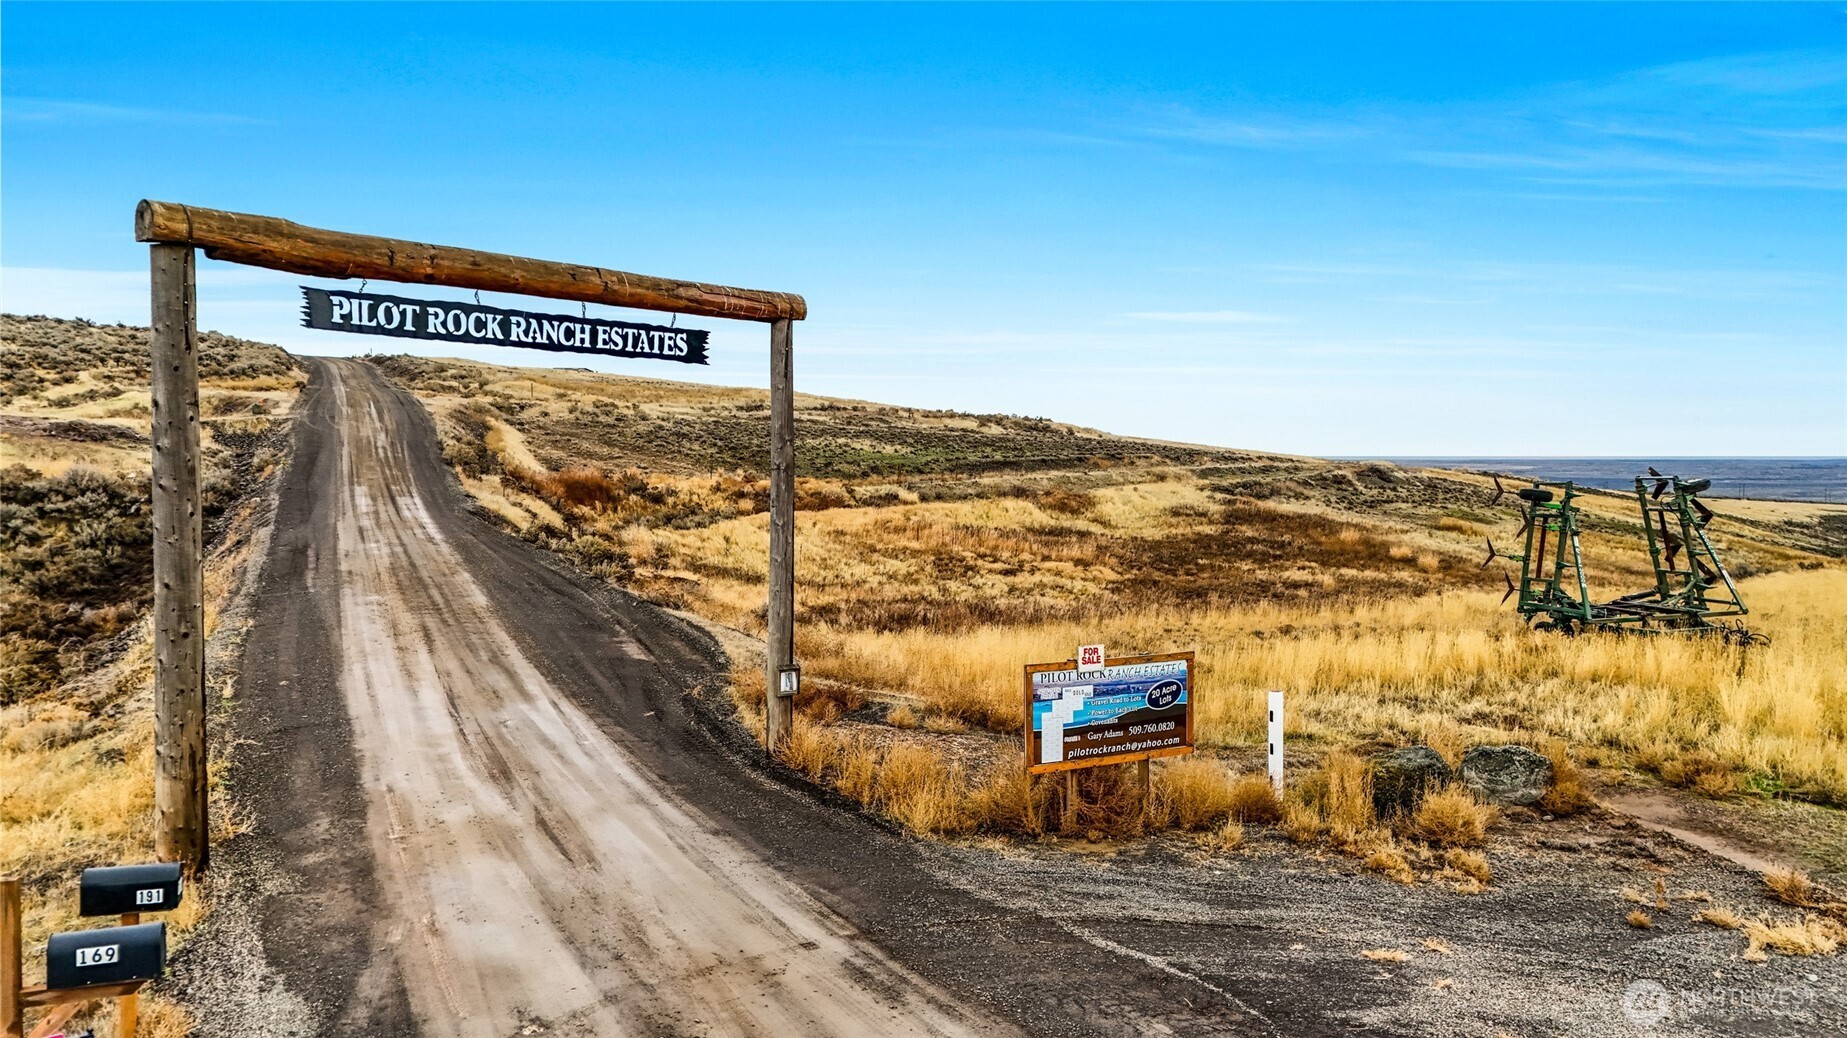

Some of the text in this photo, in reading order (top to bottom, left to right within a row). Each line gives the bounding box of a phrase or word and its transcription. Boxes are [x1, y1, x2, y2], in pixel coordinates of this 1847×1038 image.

[329, 295, 688, 356] PILOT ROCK RANCH ESTATES
[1083, 647, 1099, 656] FOR
[1081, 655, 1101, 665] SALE
[1040, 662, 1182, 684] PILOT ROCK RANCH ESTATES
[1151, 684, 1177, 699] 20 Acre
[1109, 696, 1123, 704] Road
[1159, 694, 1172, 705] Lots
[1091, 708, 1107, 716] Power
[1087, 731, 1103, 741] Gary
[1103, 729, 1124, 739] Adams
[1128, 721, 1175, 736] 509.760.0820
[1068, 736, 1180, 759] pilotrockranch@yahoo.com
[139, 889, 161, 903] 191
[79, 947, 116, 965] 169
